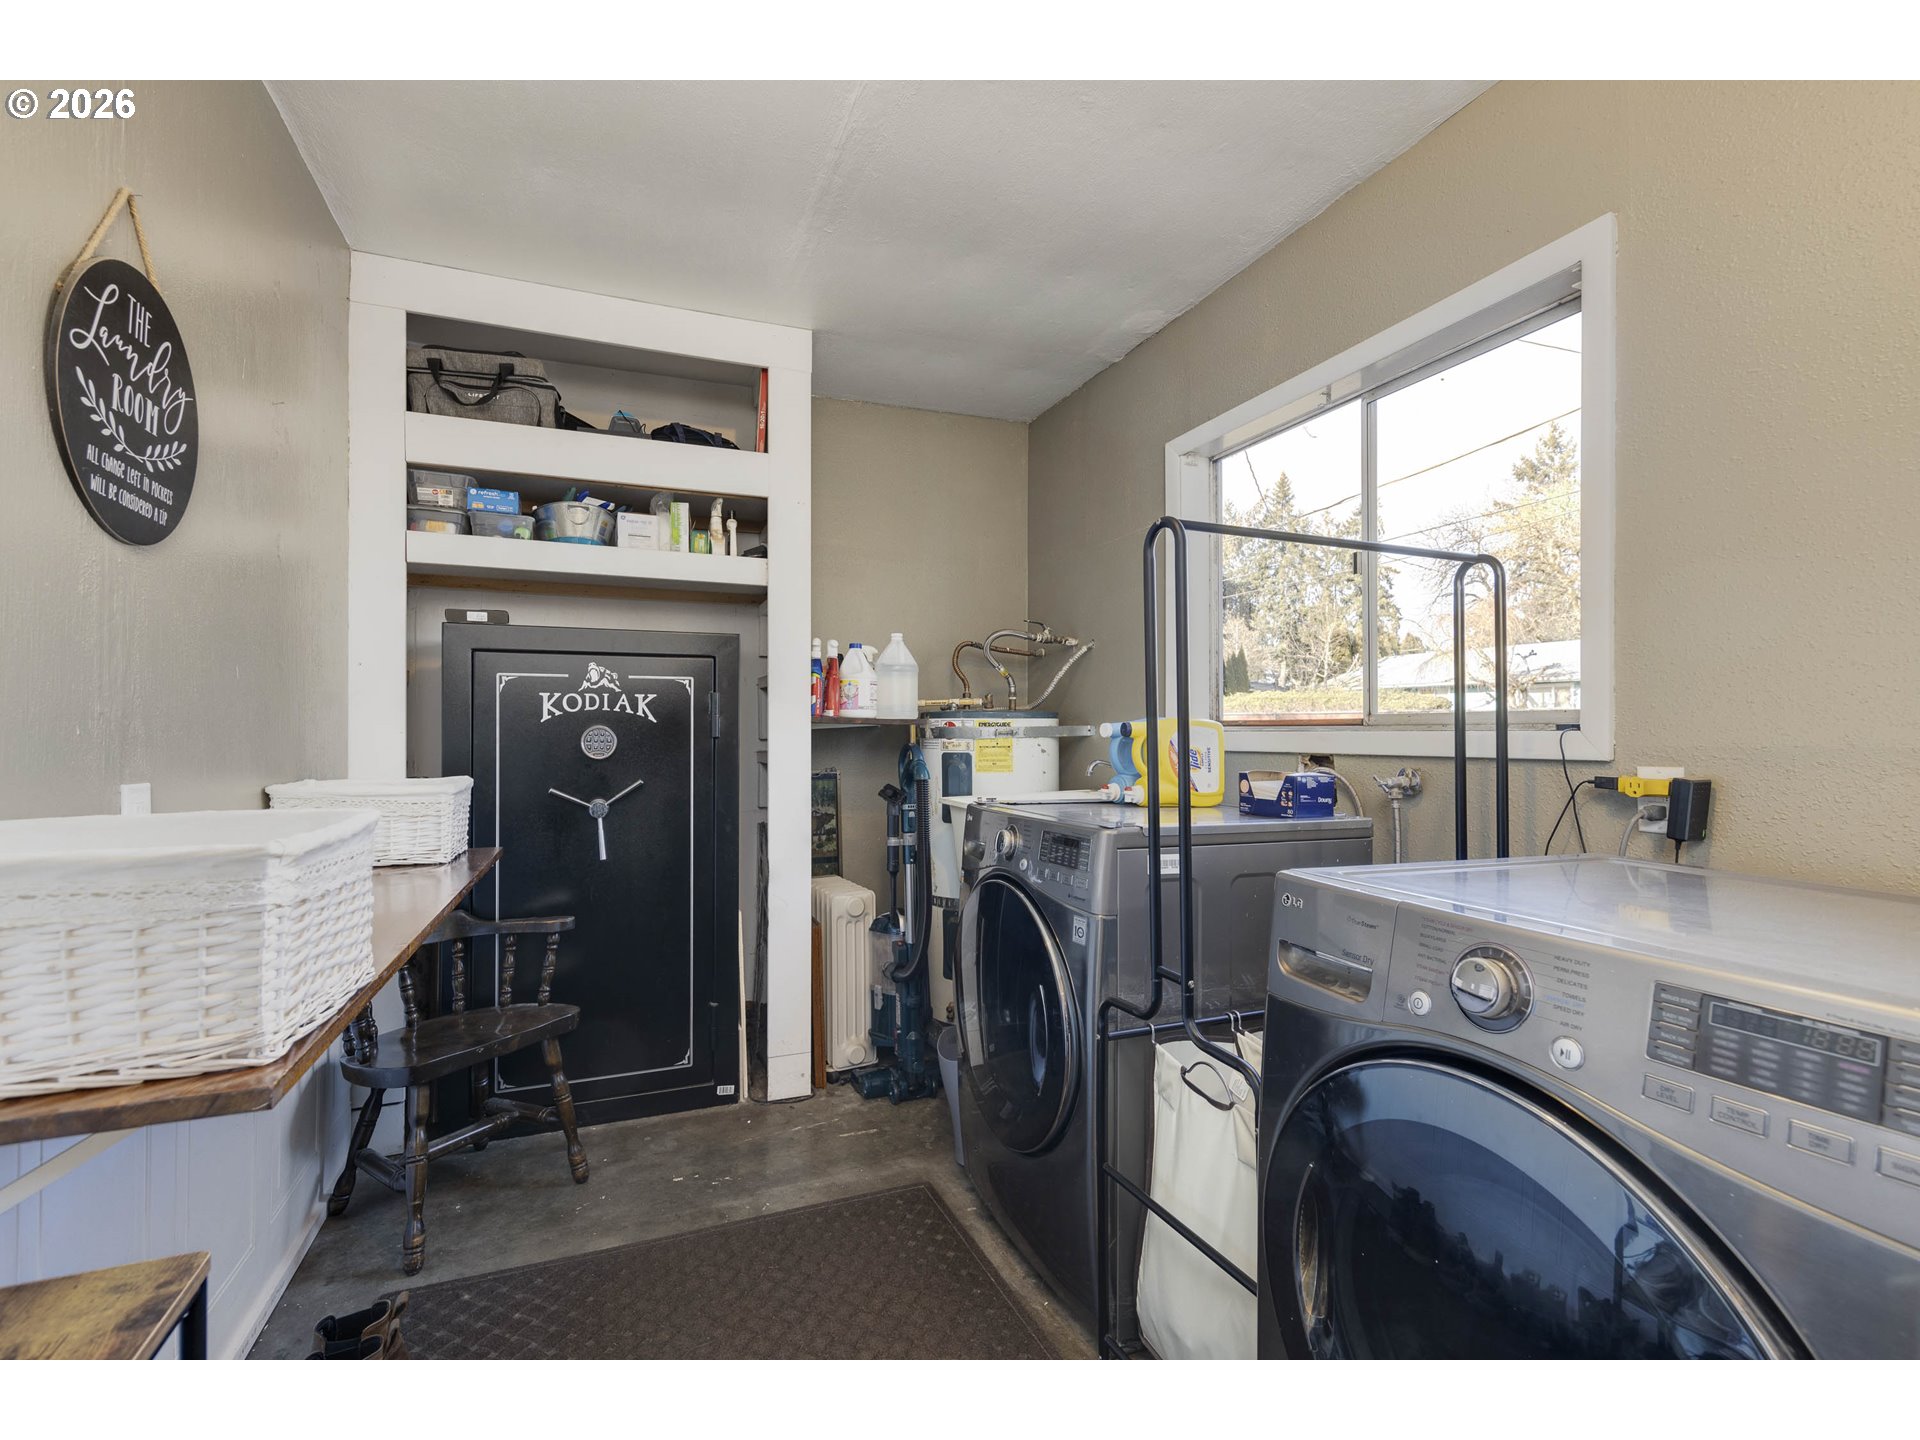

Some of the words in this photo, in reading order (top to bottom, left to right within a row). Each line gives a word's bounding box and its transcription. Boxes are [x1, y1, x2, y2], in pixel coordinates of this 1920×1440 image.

[127, 293, 153, 348] THE
[69, 283, 194, 435] Laundry
[111, 372, 161, 438] ROOM
[86, 443, 100, 466] ALL
[153, 507, 159, 522] A
[539, 692, 658, 723] KODIAK
[1317, 796, 1333, 805] Downy
[1342, 949, 1361, 961] Sensor
[1362, 955, 1375, 966] Dry
[1553, 955, 1573, 964] HEAVY
[1573, 959, 1591, 967] DUTY
[1570, 968, 1590, 979] PRESS
[1556, 977, 1588, 990] DELICATES
[1562, 991, 1587, 1003] TOWELS
[1552, 1004, 1572, 1014] SPEED
[1572, 1008, 1584, 1017] DRY
[1559, 1020, 1570, 1028] AIR
[1570, 1023, 1583, 1031] DRY
